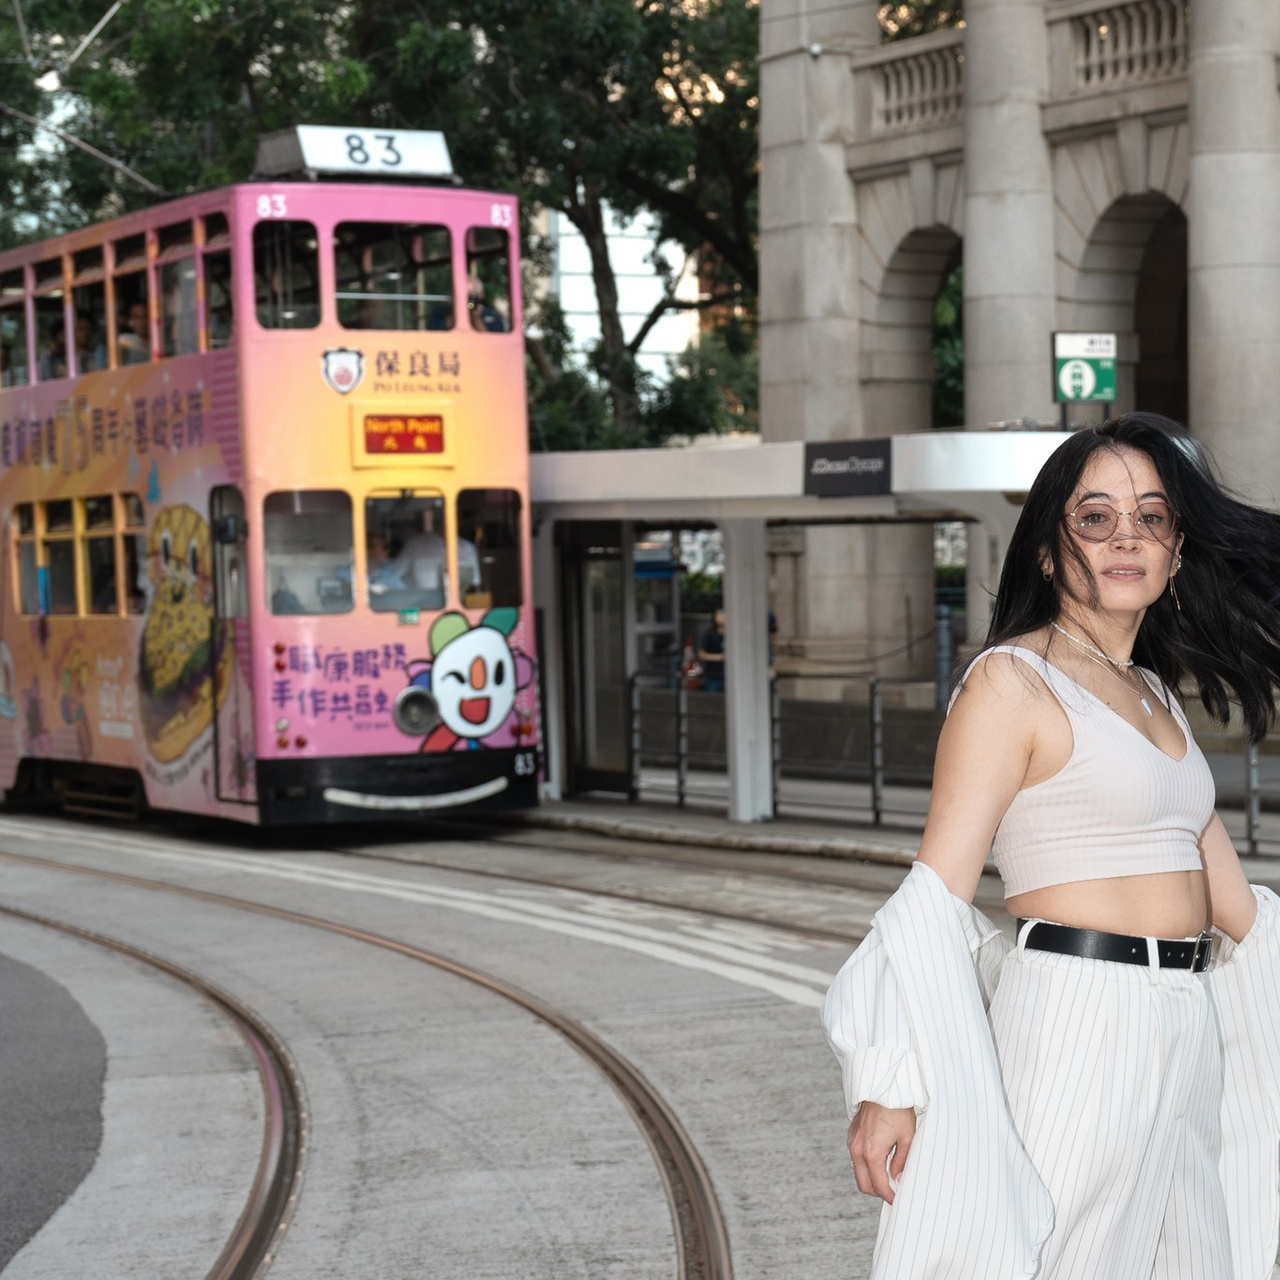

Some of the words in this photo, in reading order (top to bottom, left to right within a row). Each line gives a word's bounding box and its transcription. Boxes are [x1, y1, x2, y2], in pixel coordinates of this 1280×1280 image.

[344, 133, 403, 166] 83
[256, 194, 287, 218] 83
[489, 203, 512, 227] 83
[375, 349, 461, 377] 保良局
[366, 418, 406, 434] North
[407, 418, 441, 434] Point
[514, 752, 536, 775] 83
